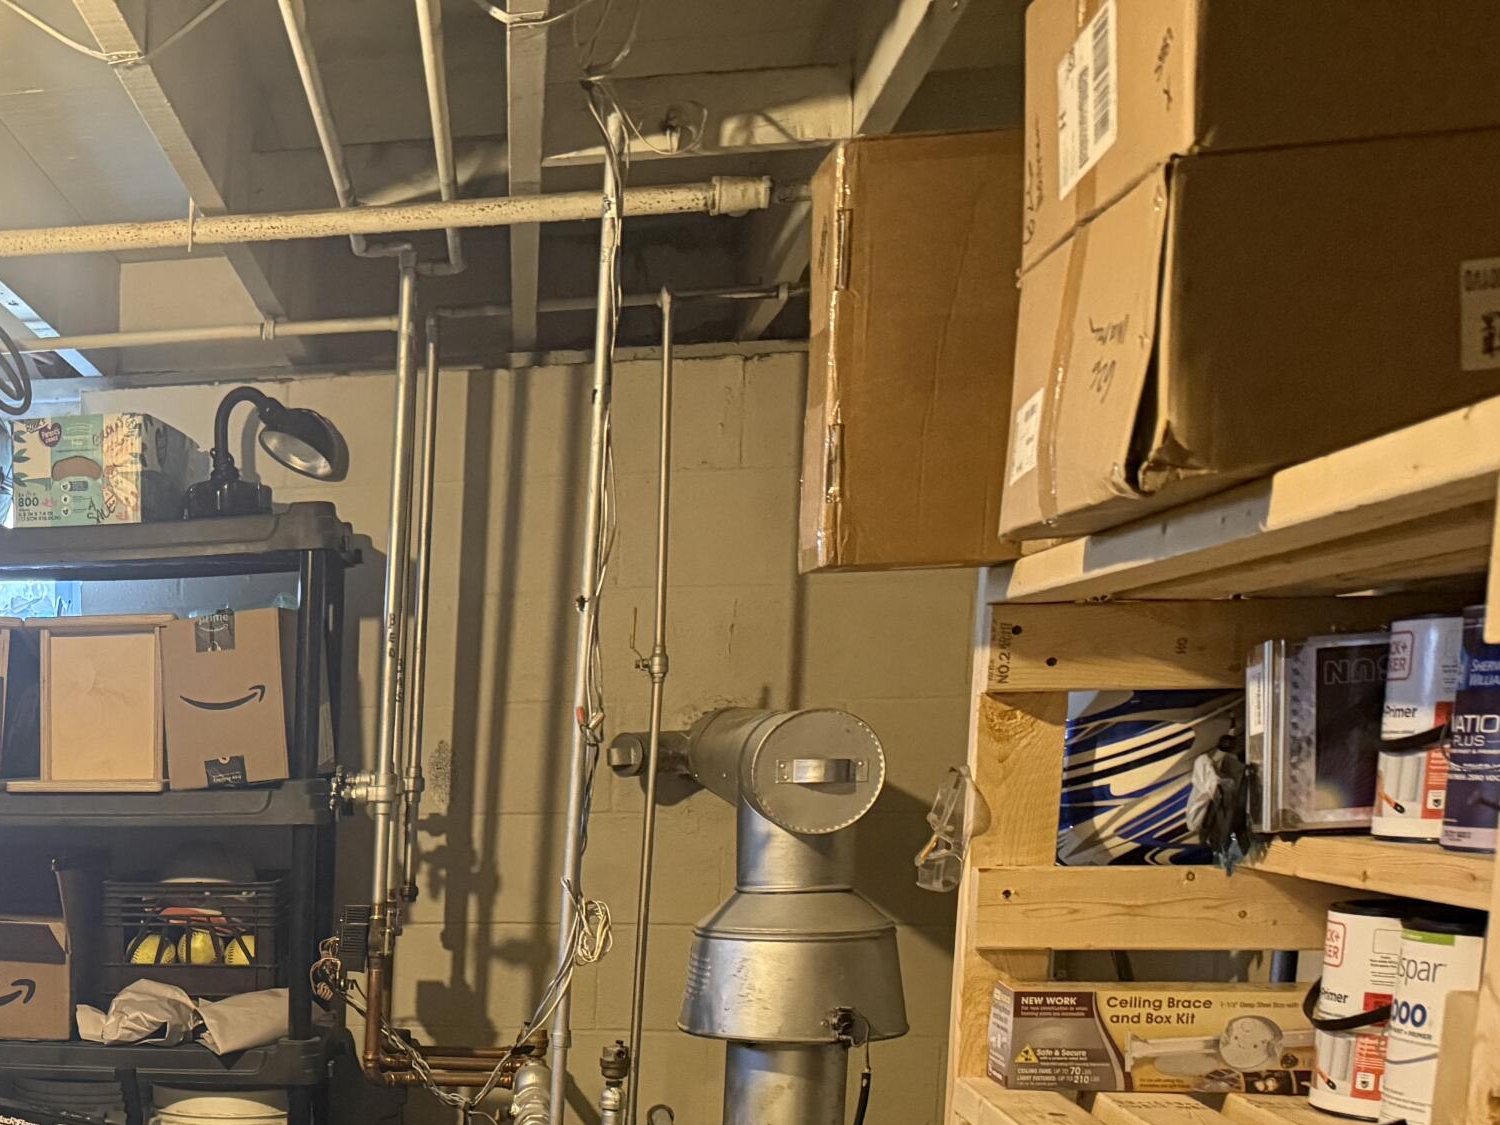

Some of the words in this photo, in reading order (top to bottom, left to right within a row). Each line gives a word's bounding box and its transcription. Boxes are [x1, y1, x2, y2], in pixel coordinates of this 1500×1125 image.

[17, 496, 39, 507] 800
[1453, 735, 1485, 747] PLUS
[1021, 996, 1044, 1005] NEW
[1046, 996, 1077, 1006] WORK
[1106, 996, 1163, 1011] Ceiling
[1167, 996, 1212, 1009] Brace
[1109, 1012, 1141, 1024] and
[1145, 1012, 1172, 1024] Box
[1176, 1012, 1195, 1025] Kit
[1037, 1049, 1054, 1057] Safe
[1062, 1049, 1087, 1057] Secure
[1070, 1066, 1081, 1075] 70
[1073, 1075, 1090, 1084] 210
